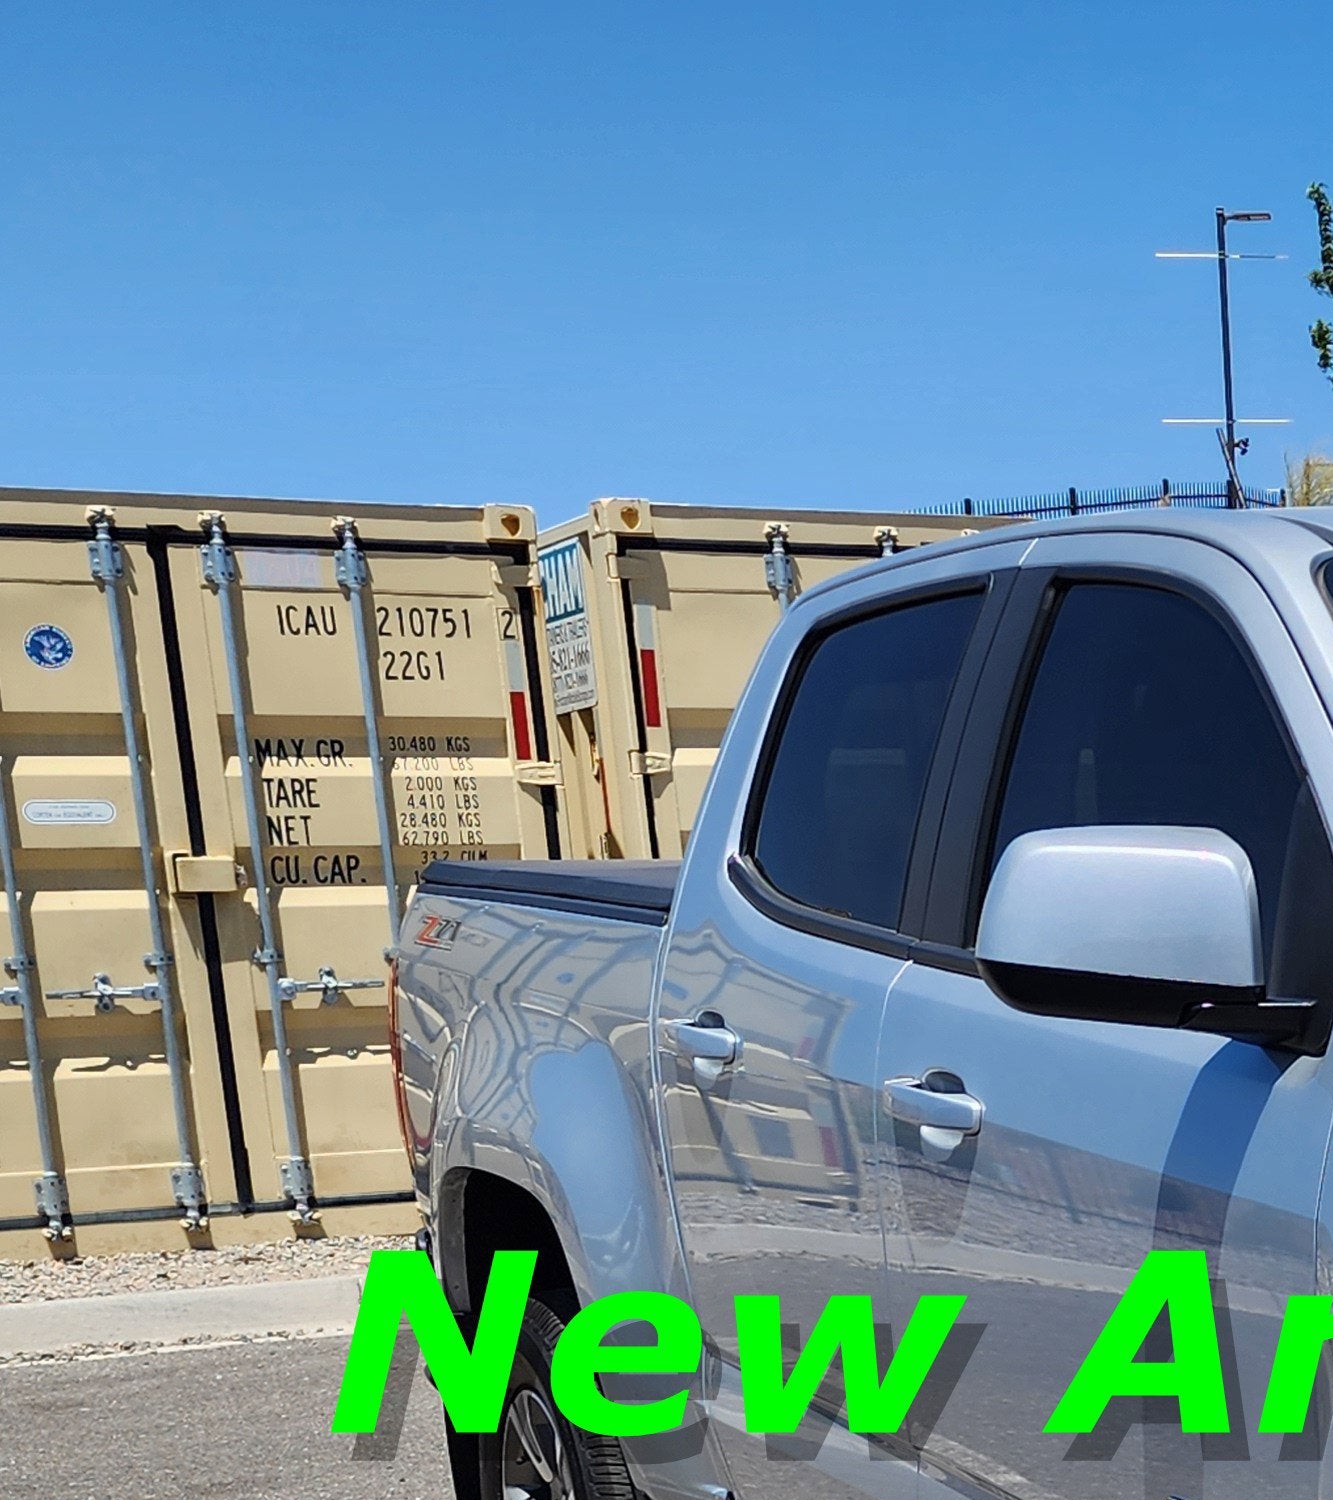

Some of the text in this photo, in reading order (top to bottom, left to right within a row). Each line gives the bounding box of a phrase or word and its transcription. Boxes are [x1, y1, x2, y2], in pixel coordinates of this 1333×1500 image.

[277, 605, 337, 636] ICAU
[377, 607, 472, 638] 210751
[499, 610, 516, 639] 2
[383, 650, 445, 680] 22G1
[388, 736, 436, 751] 30.480
[446, 737, 471, 752] KGS
[263, 776, 478, 808] TARE 2.000 KGS
[407, 794, 480, 810] 4.410 LBS
[266, 812, 482, 846] NET 28.480 KGS
[401, 831, 484, 846] 62.790 LBS
